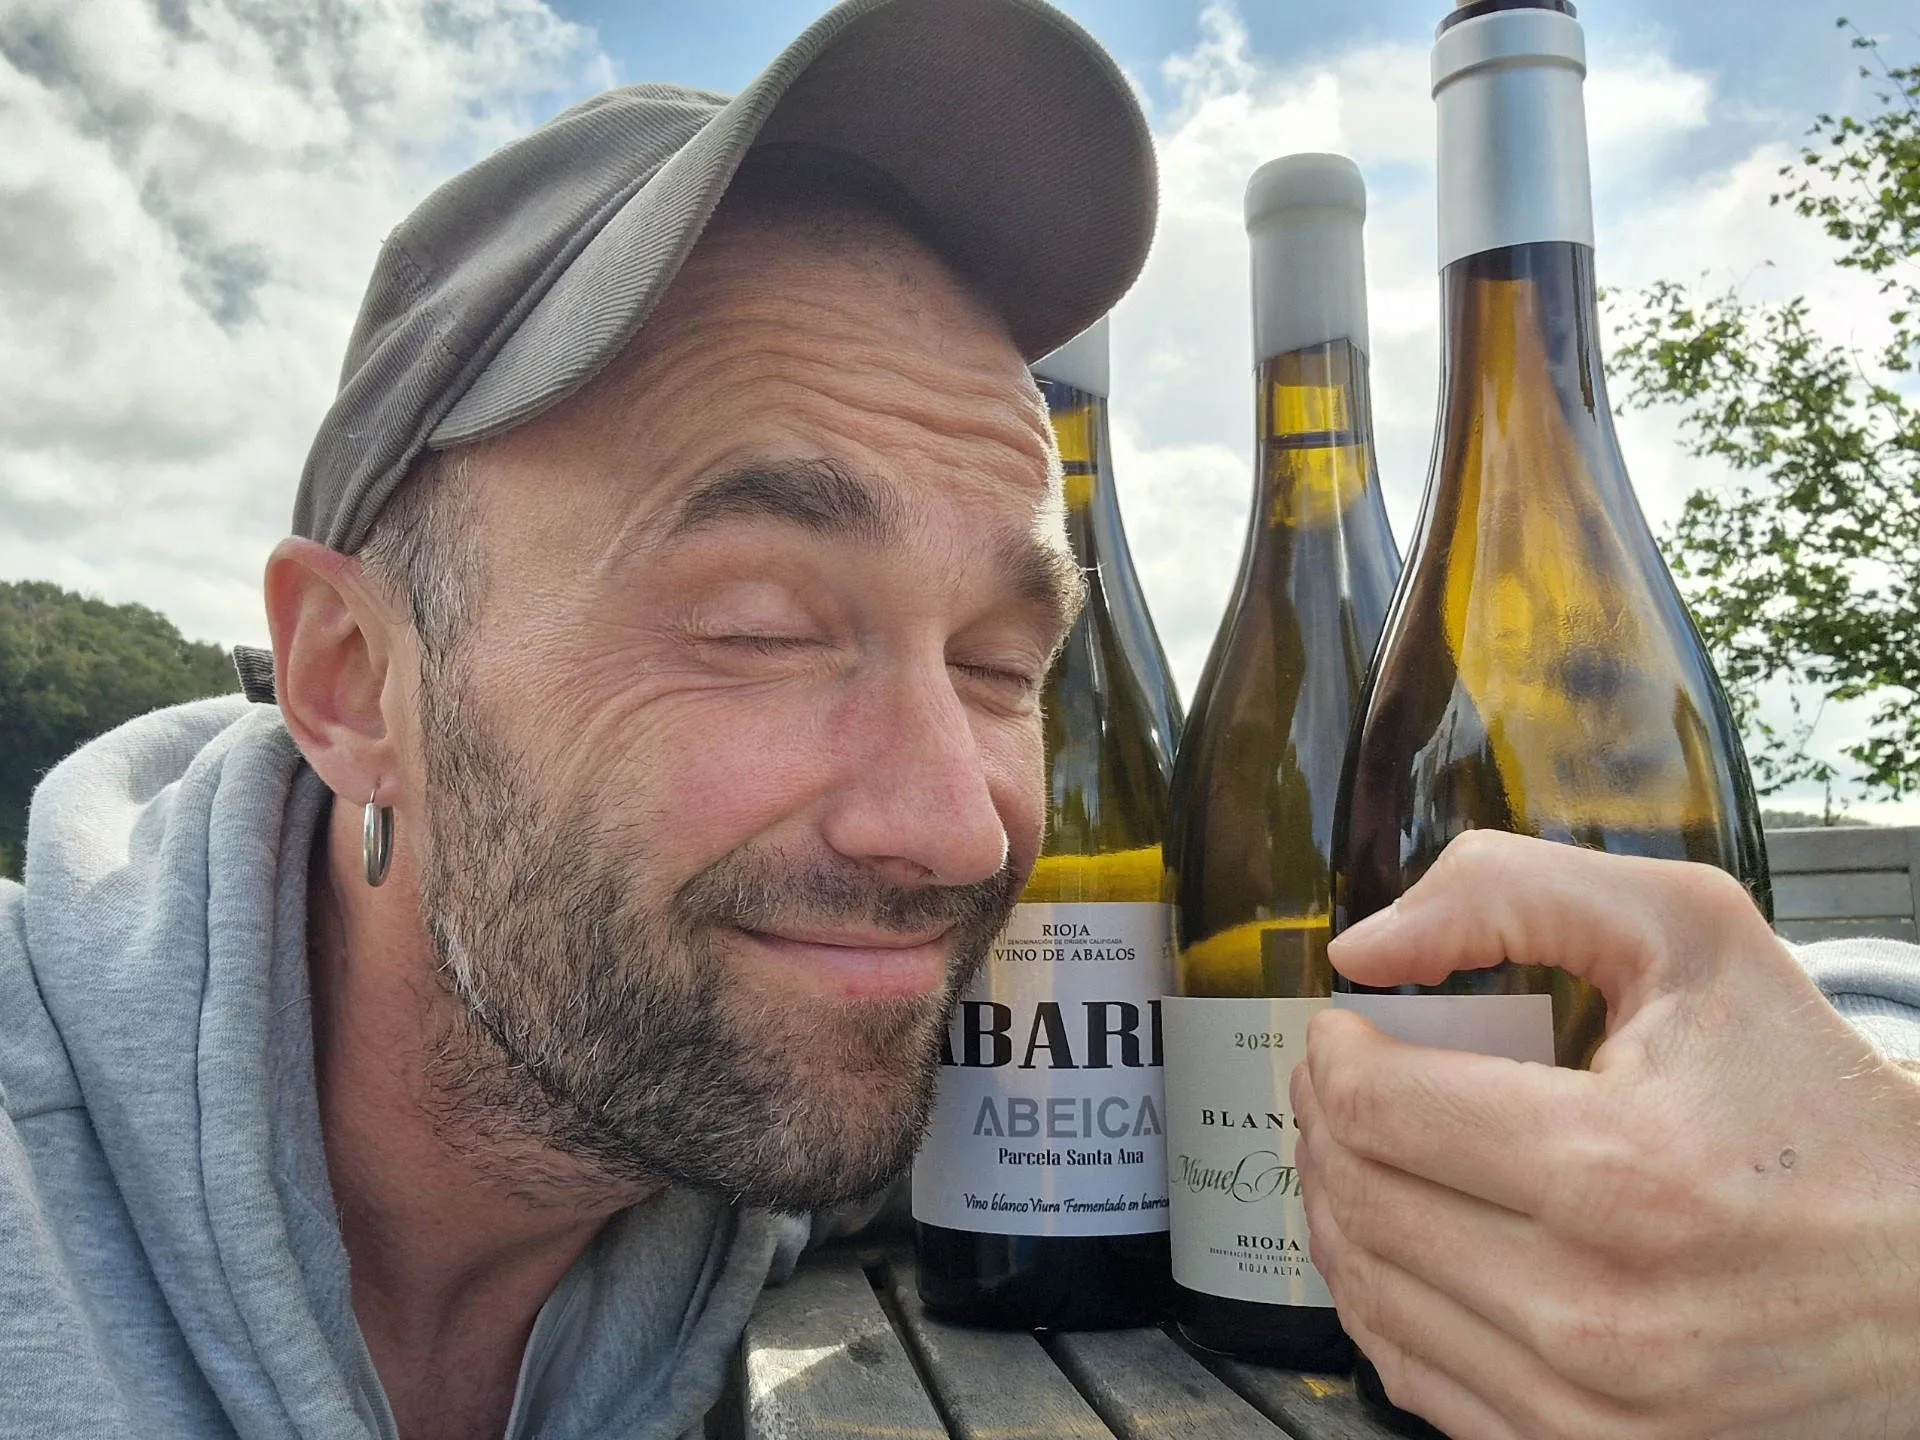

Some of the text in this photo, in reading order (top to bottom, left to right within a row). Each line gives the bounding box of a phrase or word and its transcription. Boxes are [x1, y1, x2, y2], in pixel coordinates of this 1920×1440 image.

[1042, 924, 1091, 938] RIOJA
[995, 948, 1135, 962] VINO DE ABALOS
[1234, 1032, 1284, 1050] 2022
[972, 1095, 1162, 1138] ABEICA
[1201, 1109, 1300, 1129] BLAN
[999, 1147, 1144, 1166] Parcela Santa Ana
[1170, 1150, 1279, 1203] Miguel
[963, 1192, 988, 1210] Vino
[990, 1192, 1028, 1213] blanco
[1029, 1197, 1060, 1213] Viura
[1063, 1194, 1126, 1213] Fermentado
[1127, 1201, 1139, 1211] en
[1237, 1234, 1301, 1251] RIOJA
[1238, 1262, 1301, 1277] RIOJA ALTA
